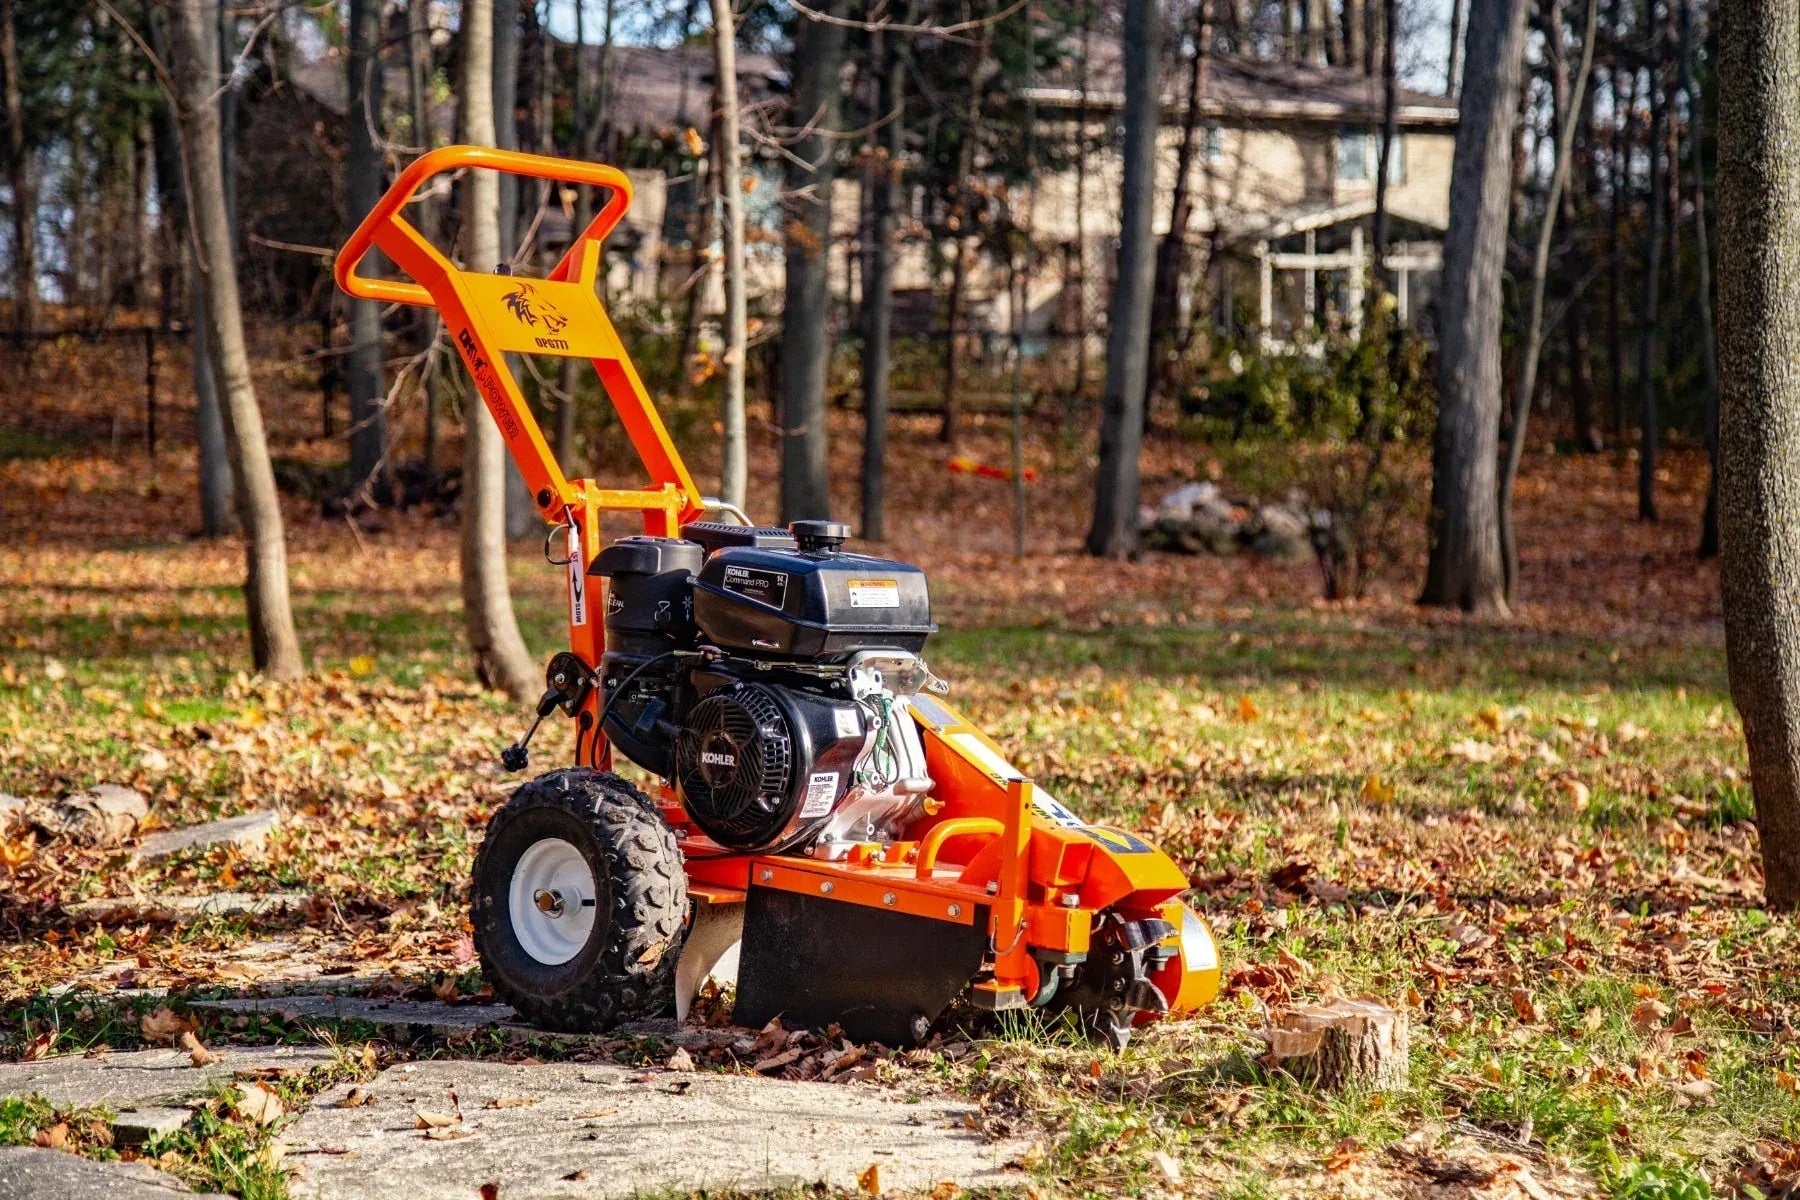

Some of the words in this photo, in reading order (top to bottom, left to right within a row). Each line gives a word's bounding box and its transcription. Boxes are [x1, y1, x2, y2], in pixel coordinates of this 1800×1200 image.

[535, 337, 569, 350] OPG777
[483, 376, 519, 441] POWER
[727, 568, 750, 578] KOHLER
[725, 575, 755, 586] Command
[755, 579, 770, 589] PRO
[701, 752, 735, 767] KOHLER
